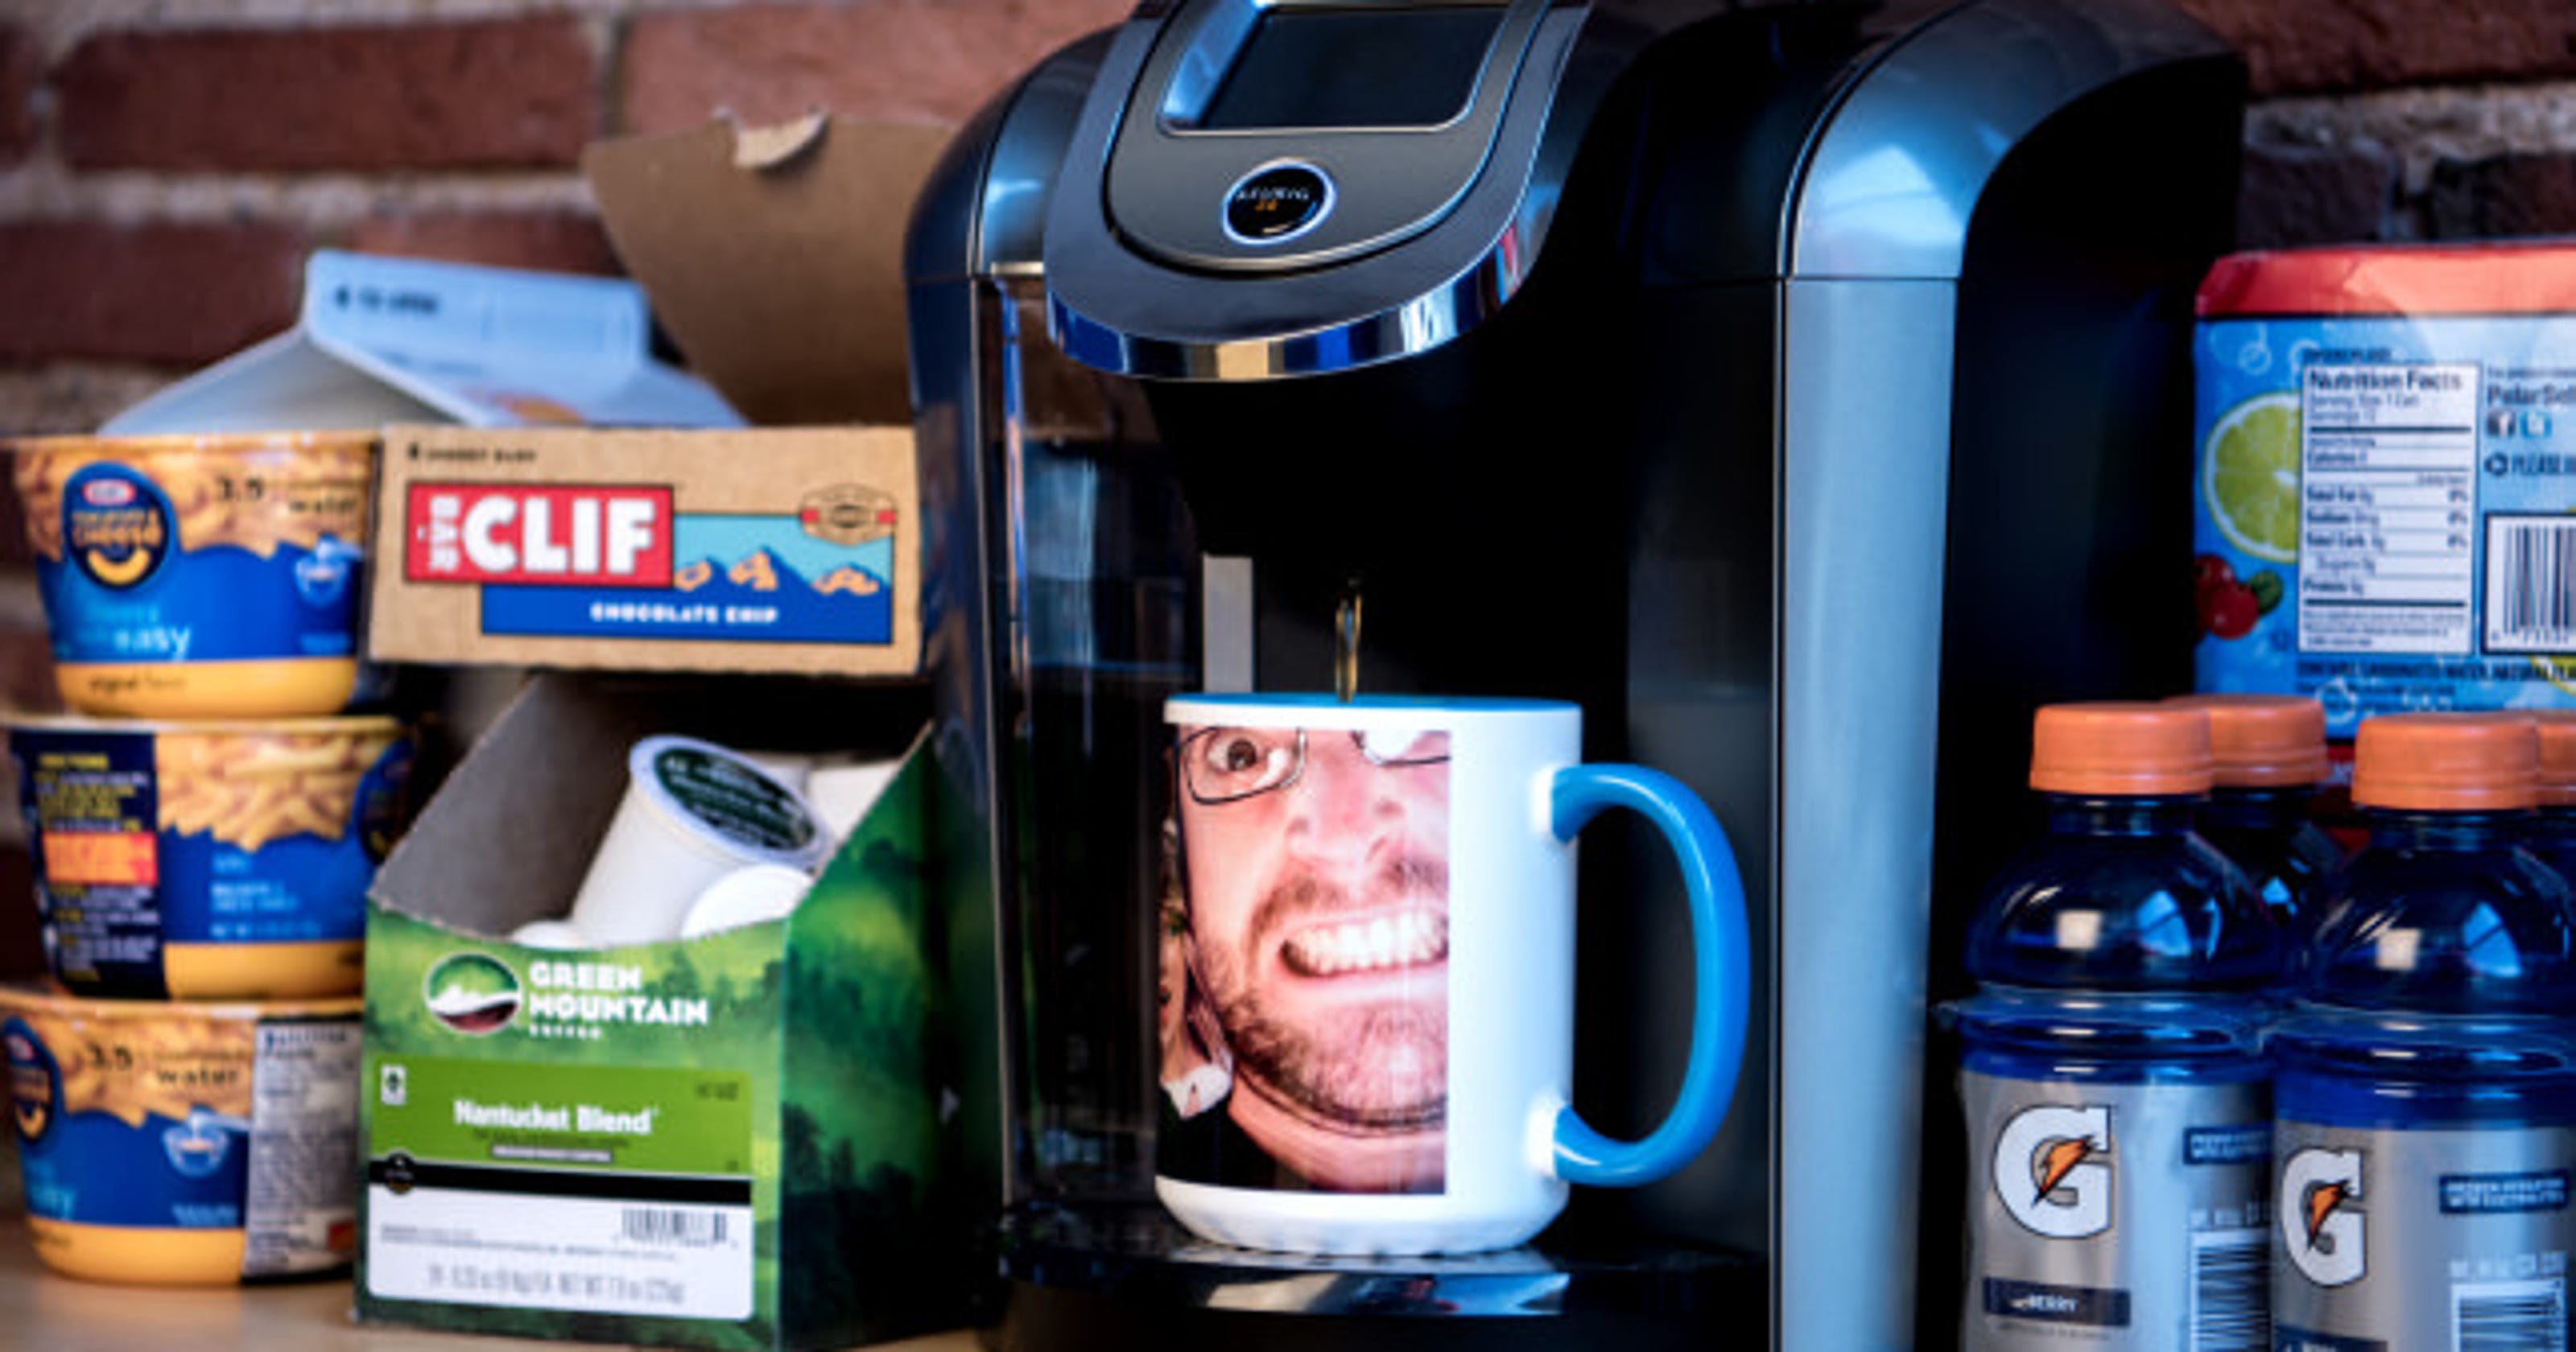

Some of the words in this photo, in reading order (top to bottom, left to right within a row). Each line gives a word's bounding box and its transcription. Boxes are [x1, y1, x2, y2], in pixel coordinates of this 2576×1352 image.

[2310, 369, 2403, 390] Nutrition
[2406, 369, 2462, 390] Facts
[429, 495, 460, 571] BAR
[462, 494, 655, 575] CLIF
[590, 602, 719, 624] CHOCOLATE
[725, 606, 778, 625] CHIP
[529, 961, 642, 989] GREEN
[529, 992, 709, 1025] MOUNTAIN
[453, 1099, 569, 1131] Nantucket
[576, 1104, 652, 1134] Blend
[1993, 1105, 2112, 1239] G
[2281, 1146, 2368, 1288] G
